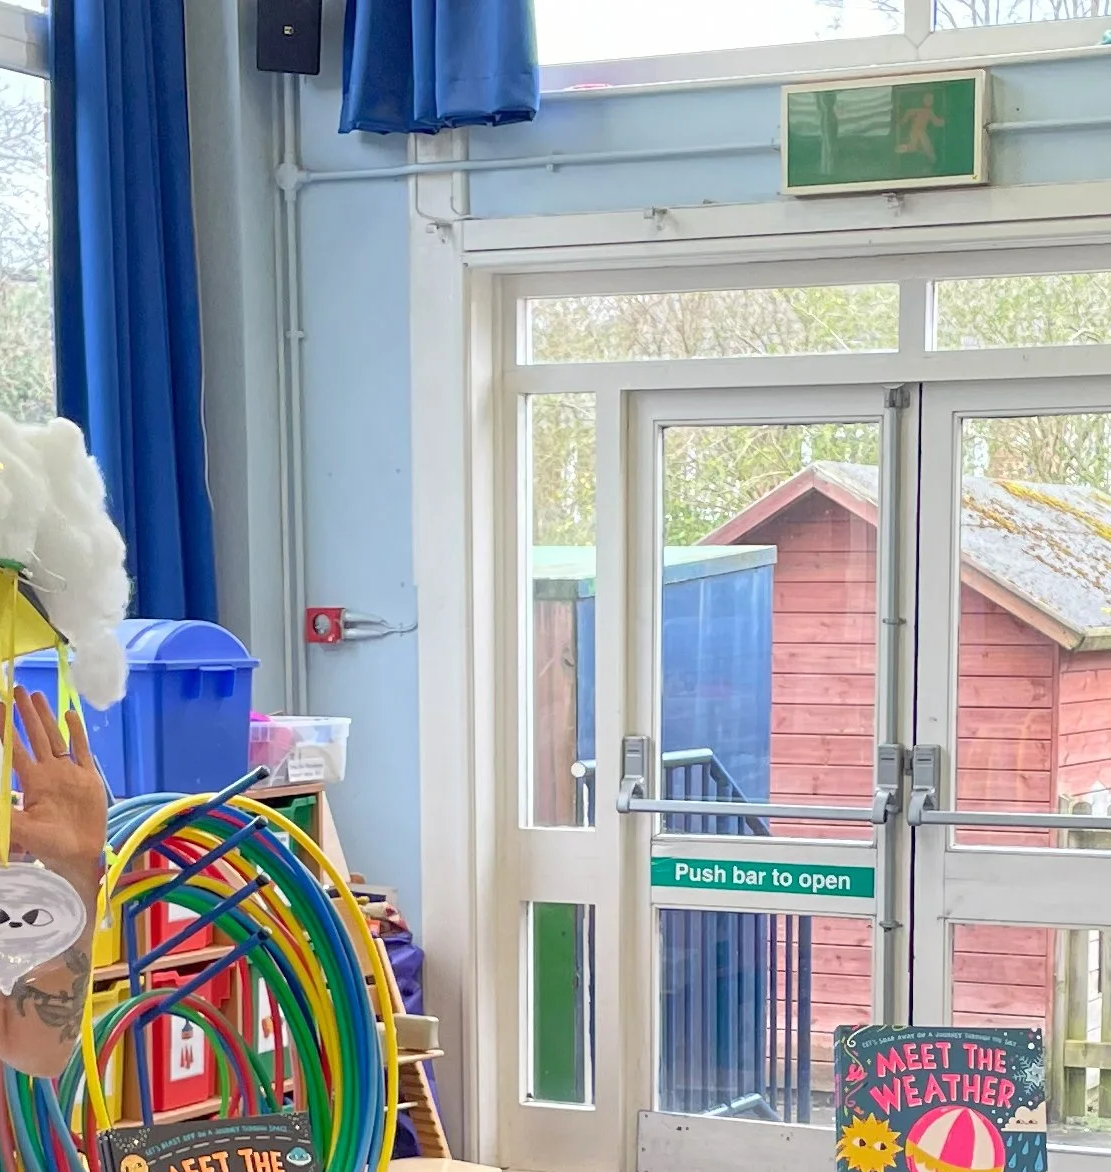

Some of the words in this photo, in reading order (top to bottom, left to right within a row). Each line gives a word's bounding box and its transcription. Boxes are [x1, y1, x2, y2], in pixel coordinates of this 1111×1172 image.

[675, 862, 726, 884] Push
[732, 865, 766, 886] bar
[772, 868, 793, 887] to
[798, 872, 851, 893] open
[876, 1041, 952, 1078] MEET
[962, 1042, 1007, 1074] THE
[869, 1073, 1016, 1115] WEATHER
